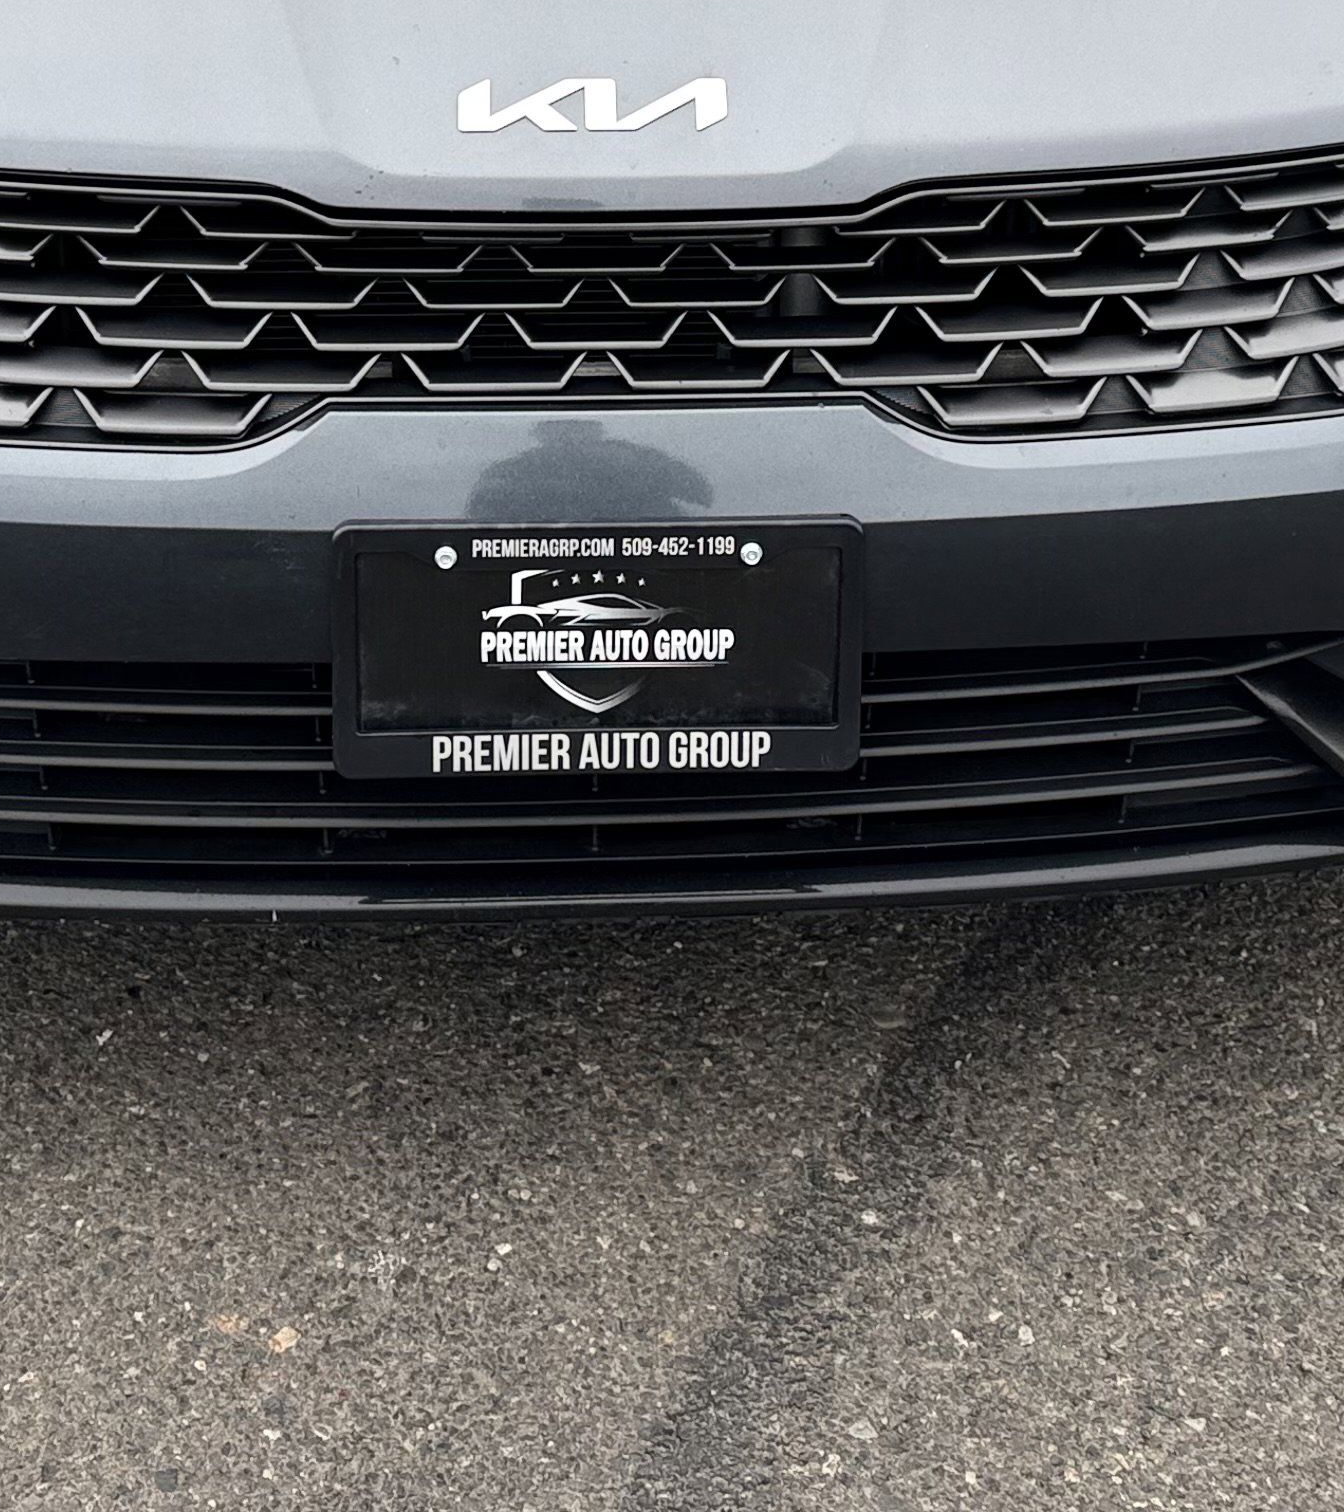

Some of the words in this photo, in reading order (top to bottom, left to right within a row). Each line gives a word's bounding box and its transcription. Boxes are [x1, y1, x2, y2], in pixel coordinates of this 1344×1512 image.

[457, 77, 728, 133] KIA
[472, 538, 615, 559] PREMIERAGRP.COM
[621, 536, 736, 557] 509-452-1199
[480, 629, 584, 663] PREMIER
[589, 629, 649, 661] AUTO
[654, 628, 735, 661] GROUP
[432, 734, 570, 773] PREMIER
[578, 732, 659, 770] AUTO
[668, 731, 772, 769] GROUP
